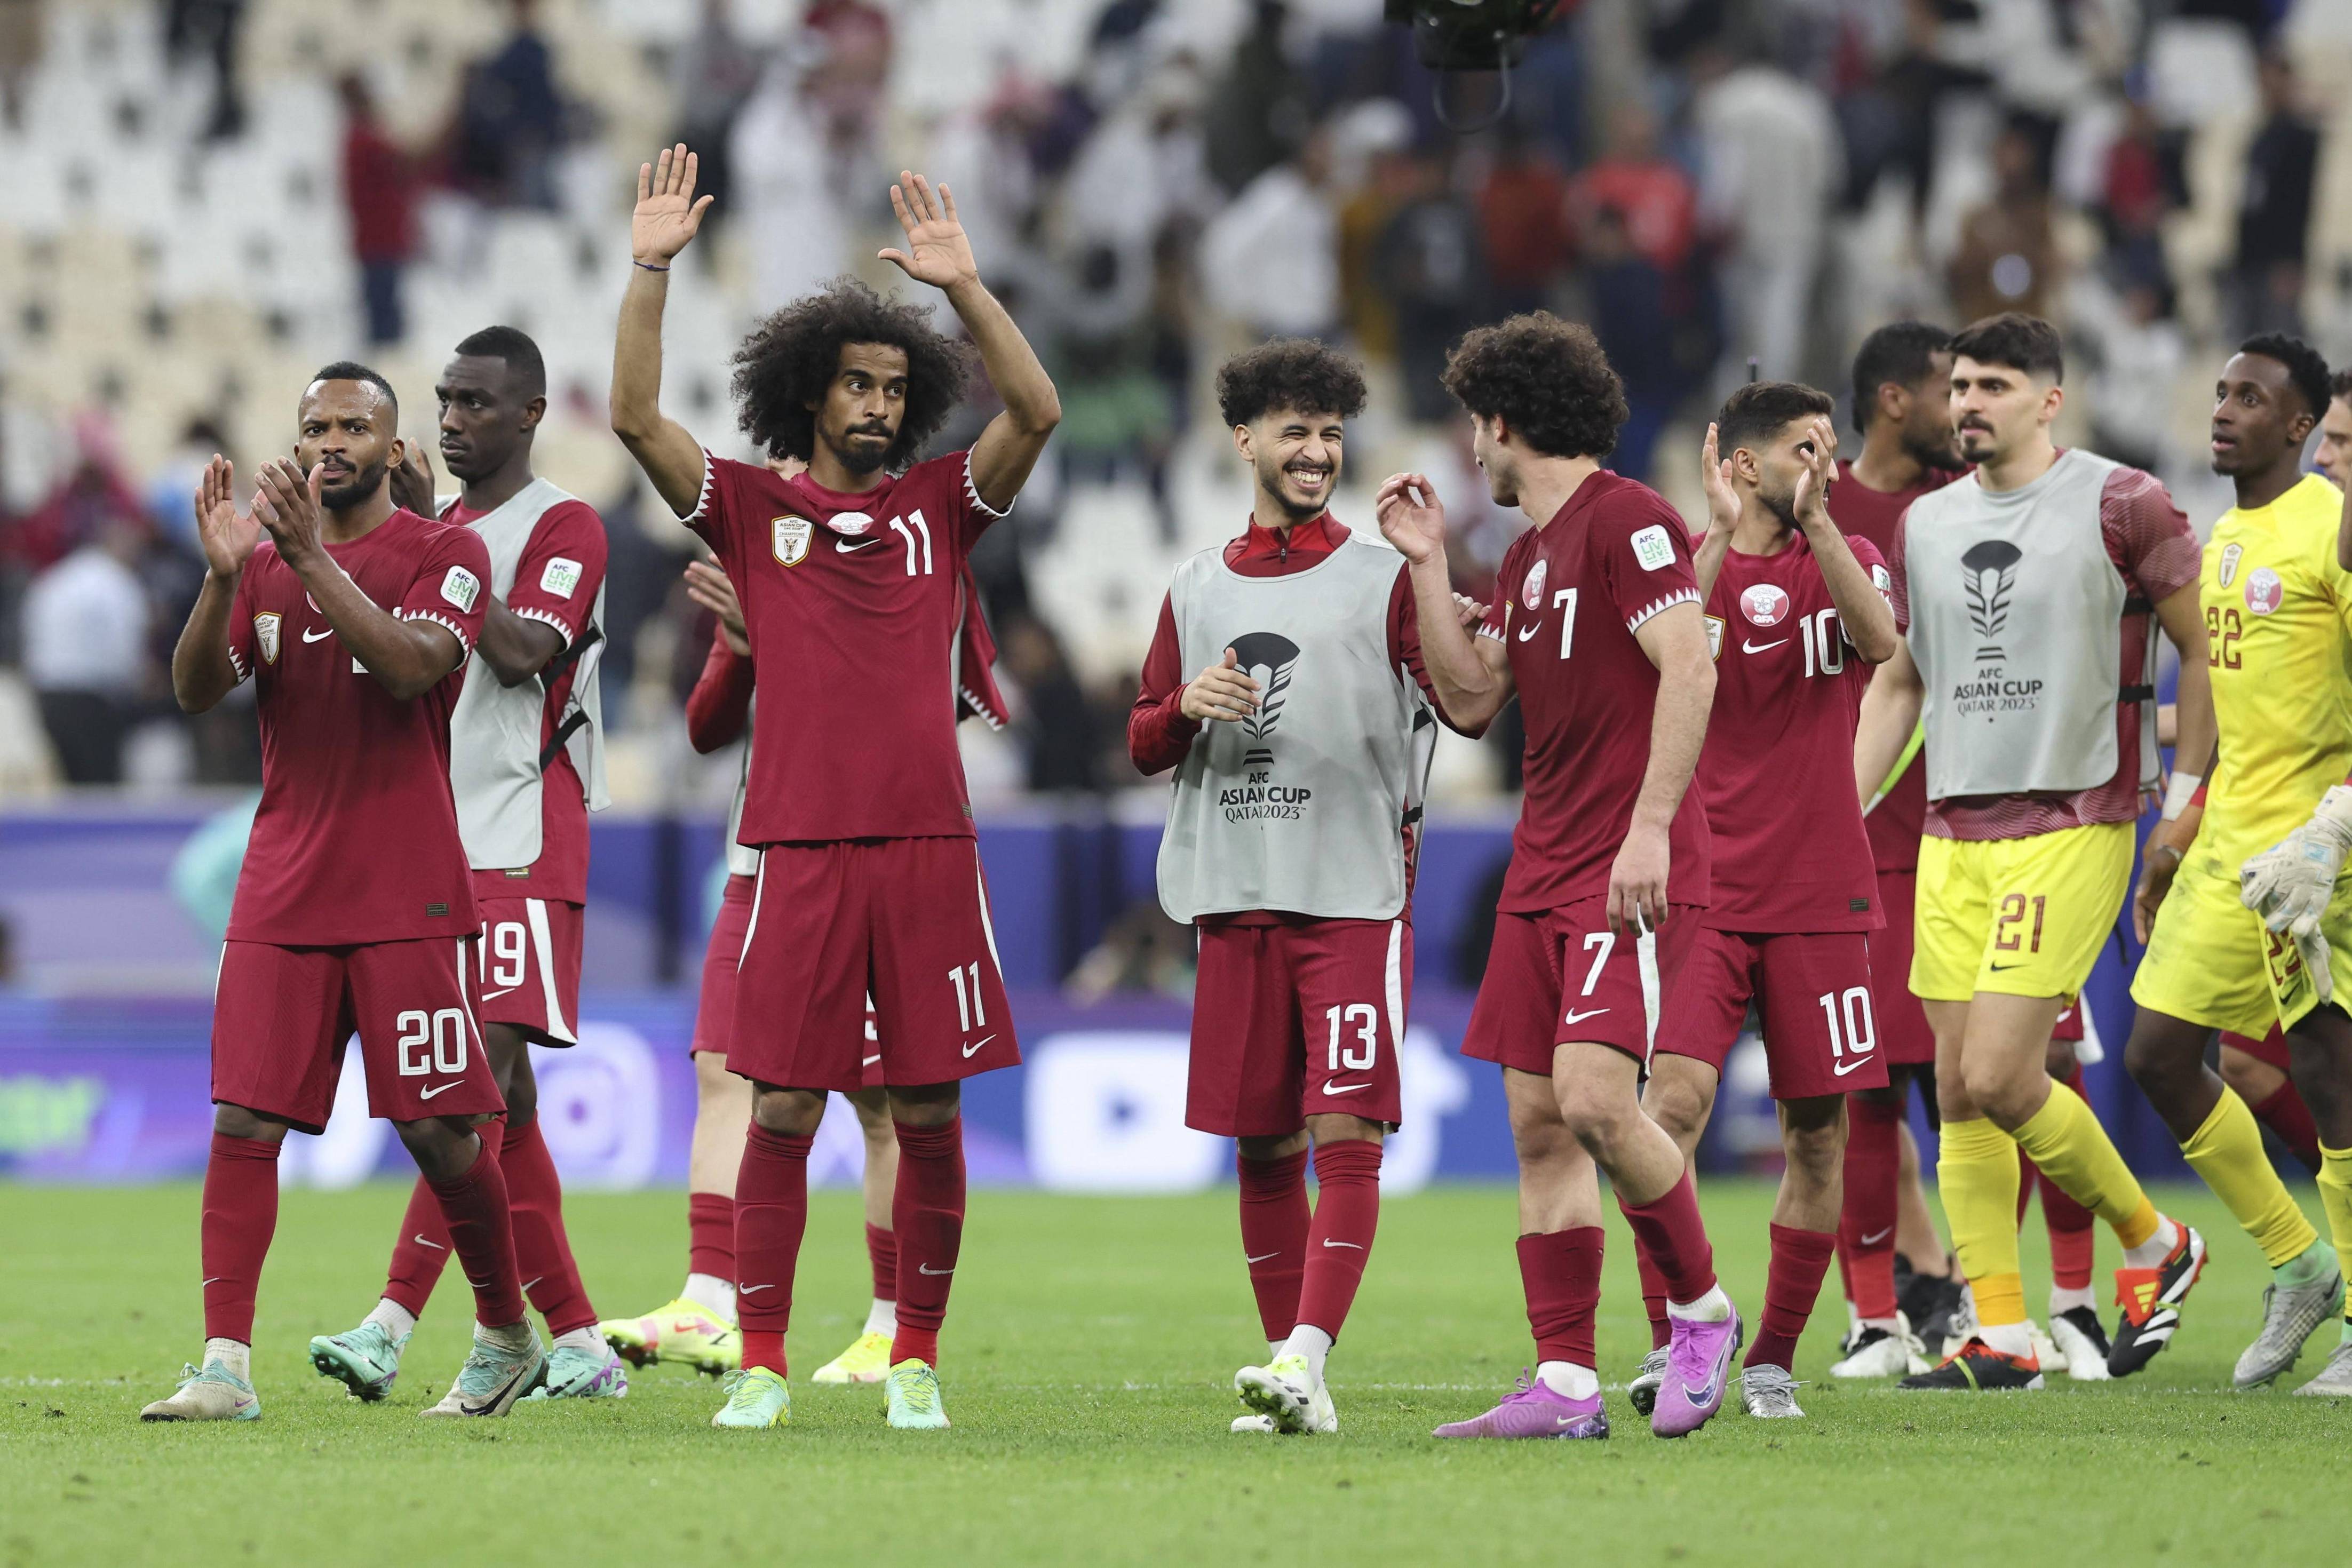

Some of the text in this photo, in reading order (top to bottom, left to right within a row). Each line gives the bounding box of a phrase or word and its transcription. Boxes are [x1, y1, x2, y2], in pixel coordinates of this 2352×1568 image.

[553, 564, 569, 572] AFC
[888, 508, 933, 576] 11
[1639, 534, 1655, 544] AFC
[455, 572, 470, 584] AFC
[1553, 587, 1577, 659] 7
[1799, 608, 1844, 678] 10
[2207, 606, 2242, 670] 22
[1953, 680, 2043, 701] ASIAN CUP
[1978, 667, 2003, 680] AFC
[1958, 699, 1995, 717] QATAR
[1219, 786, 1312, 806] ASIAN CUP
[1248, 771, 1269, 784] AFC
[1225, 806, 1262, 824] QATAR
[1995, 894, 2045, 953] 21
[1580, 932, 1616, 996] 7
[948, 960, 986, 1032] 11
[1819, 986, 1875, 1057] 10
[397, 1008, 467, 1076] 20
[1326, 1003, 1377, 1070] 13
